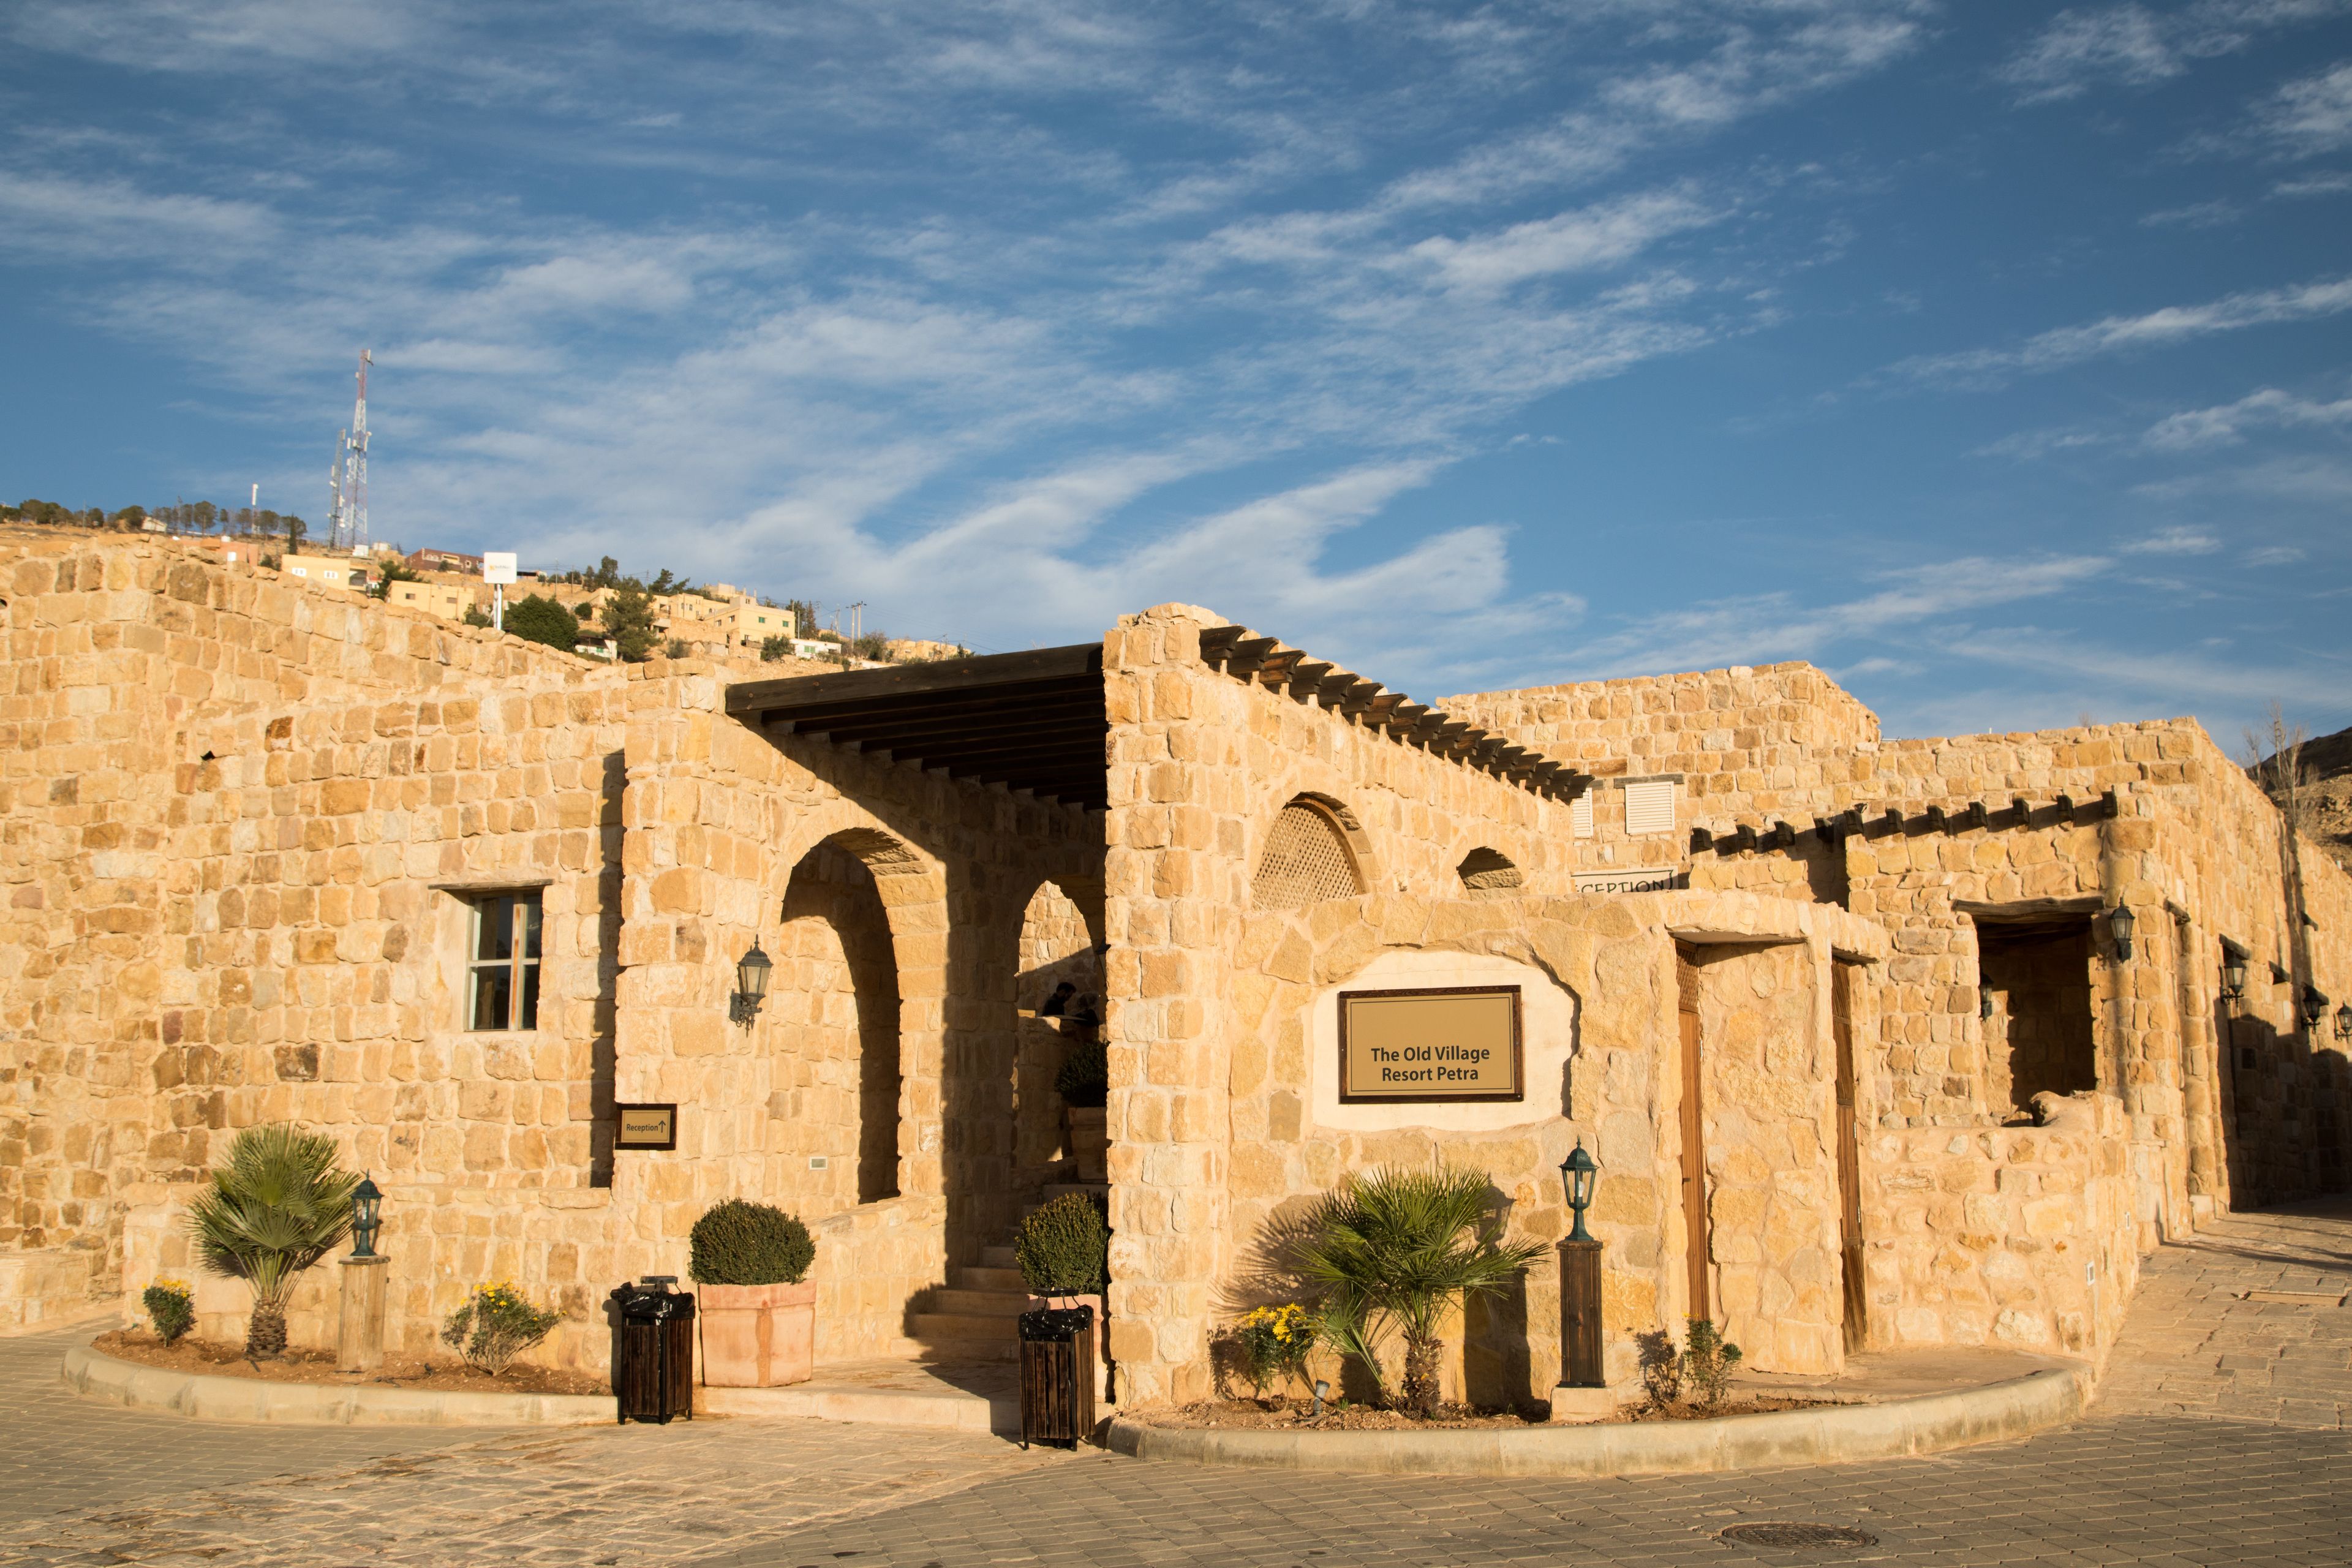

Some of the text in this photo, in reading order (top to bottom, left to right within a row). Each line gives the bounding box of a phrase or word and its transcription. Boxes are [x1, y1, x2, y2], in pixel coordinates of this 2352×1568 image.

[1371, 1046, 1490, 1064] The Old Village
[1382, 1066, 1479, 1081] Resort Petra
[626, 1123, 658, 1133] Reception
